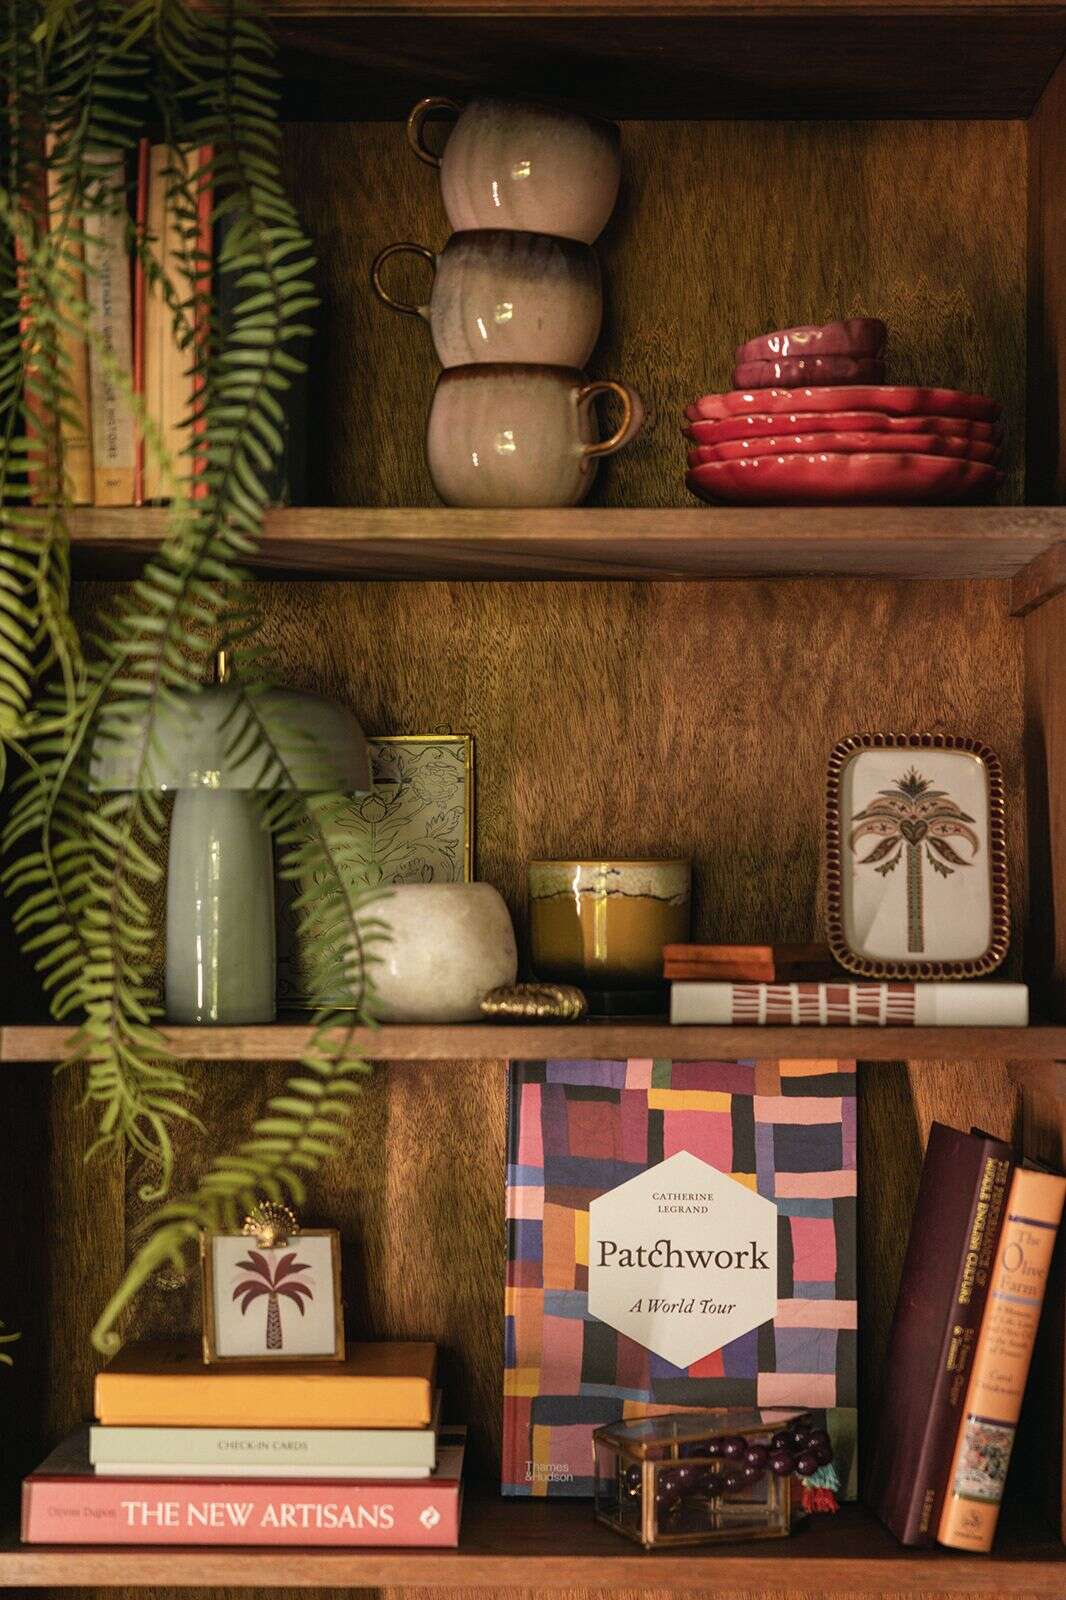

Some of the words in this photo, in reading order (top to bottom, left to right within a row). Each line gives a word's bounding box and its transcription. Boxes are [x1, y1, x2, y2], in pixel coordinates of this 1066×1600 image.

[652, 1192, 714, 1201] CATHERINE
[658, 1205, 709, 1214] LEGRAND
[597, 1240, 770, 1270] Patchwork
[1003, 1242, 1045, 1278] Olive
[958, 1252, 978, 1304] CULTURE
[630, 1299, 643, 1313] A
[648, 1299, 695, 1313] World
[700, 1298, 737, 1314] Tour
[218, 1440, 269, 1450] CHECK-IN
[272, 1441, 308, 1451] CARDS
[525, 1461, 569, 1472] Thames
[525, 1470, 574, 1482] &Hudson
[121, 1501, 180, 1527] THE
[187, 1502, 255, 1527] NEW
[260, 1503, 395, 1530] ARTISANS
